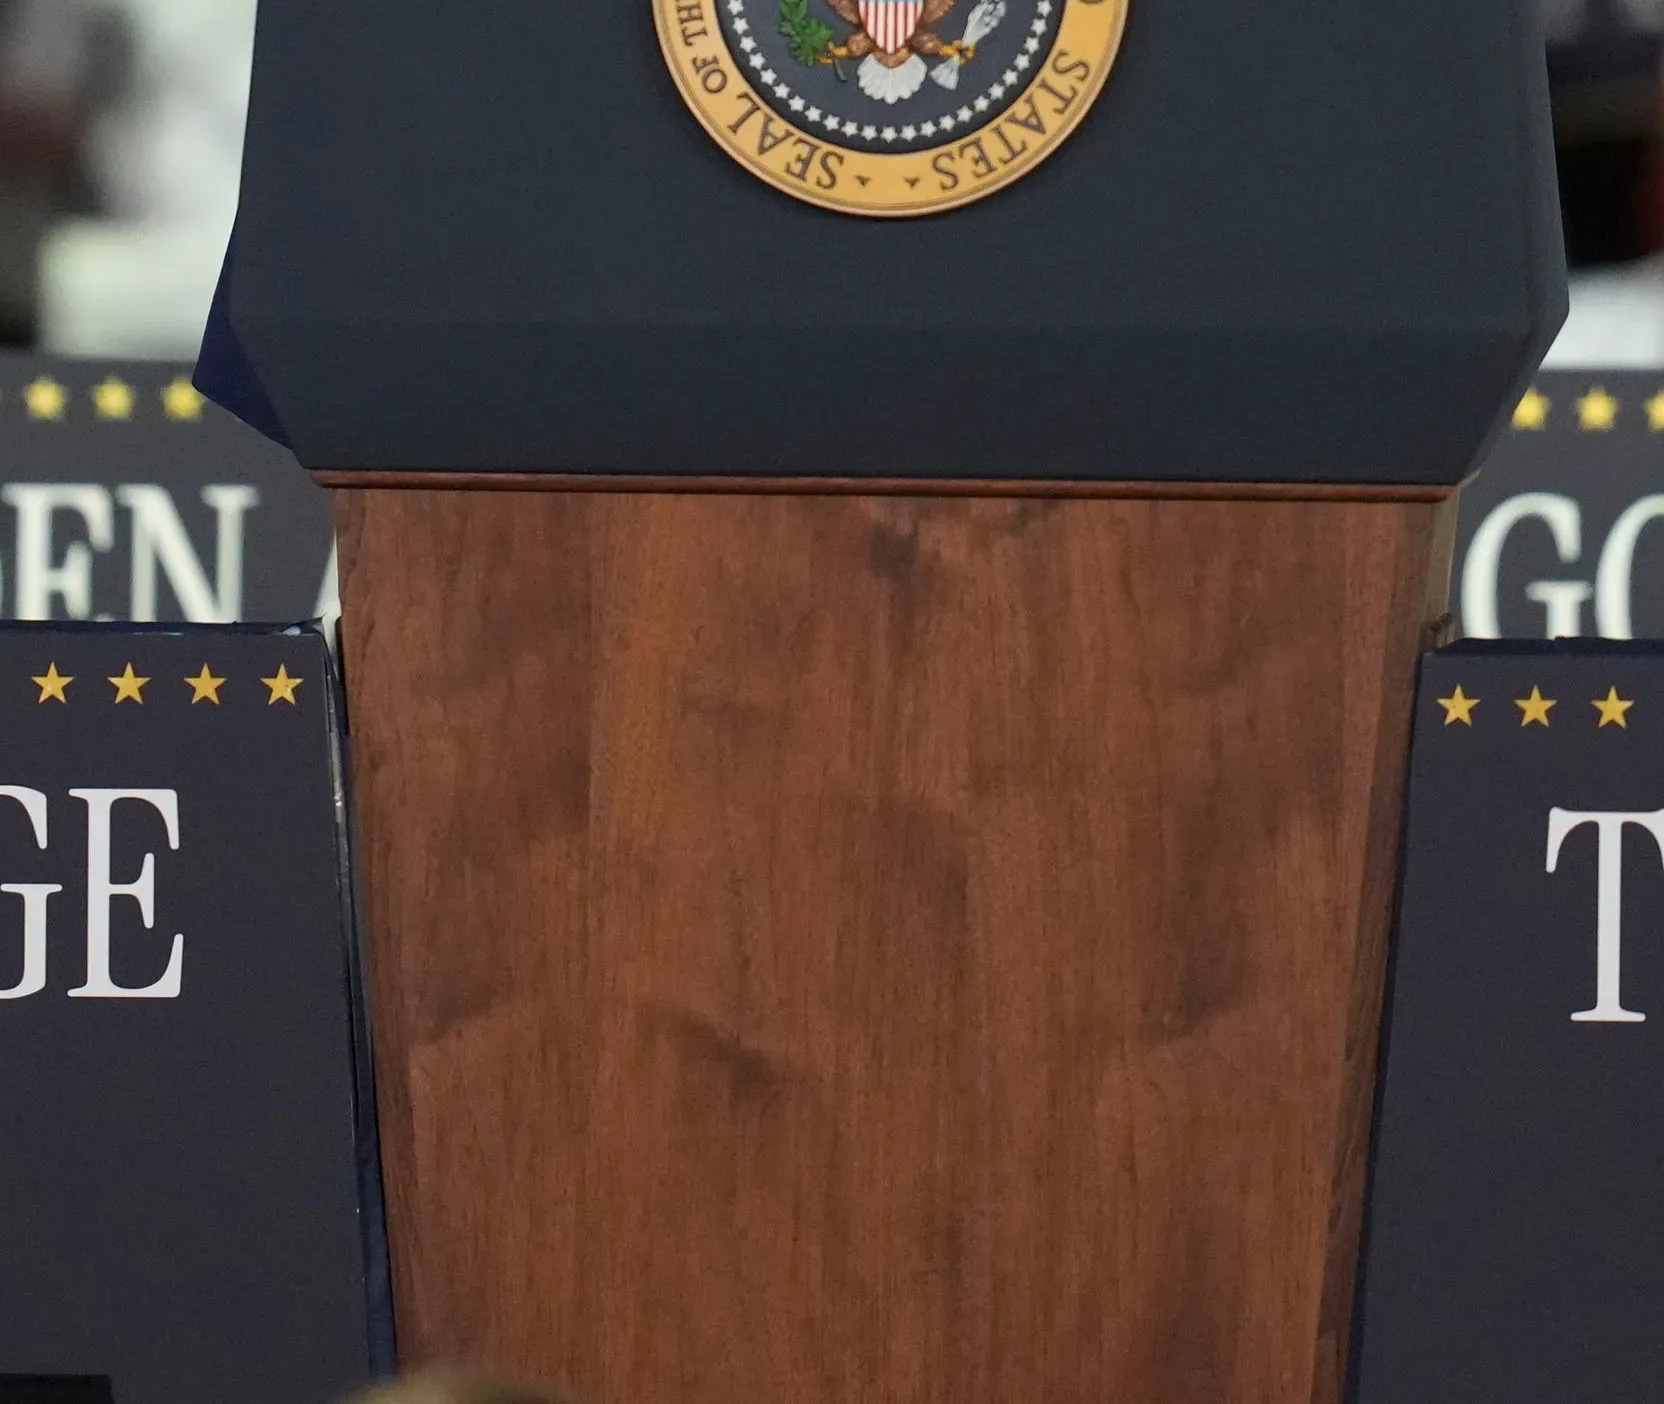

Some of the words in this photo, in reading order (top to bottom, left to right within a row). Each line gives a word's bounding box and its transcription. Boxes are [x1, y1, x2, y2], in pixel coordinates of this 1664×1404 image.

[692, 52, 729, 95] OF
[930, 48, 1091, 192] STATES
[727, 89, 844, 191] SEAL
